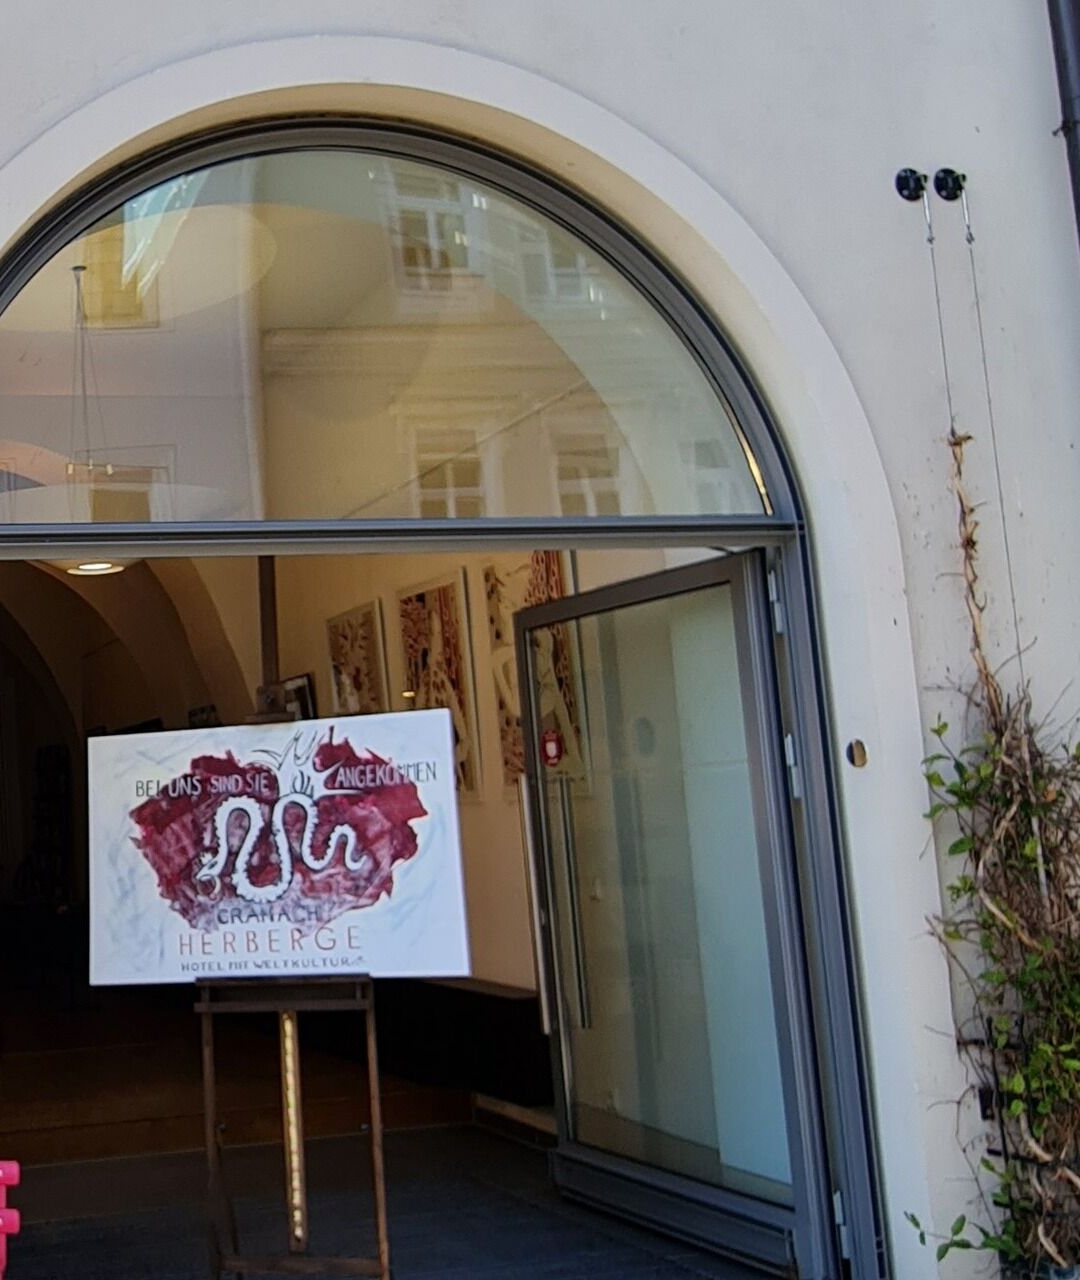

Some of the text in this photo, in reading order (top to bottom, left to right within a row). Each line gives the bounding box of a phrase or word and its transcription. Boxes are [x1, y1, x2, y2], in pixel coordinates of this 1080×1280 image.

[135, 760, 437, 798] BEI UNS SIND SIE ANGEKOMMEN
[216, 903, 320, 925] CRANACH
[178, 925, 362, 956] HERBERGE
[180, 960, 223, 972] HOTEL
